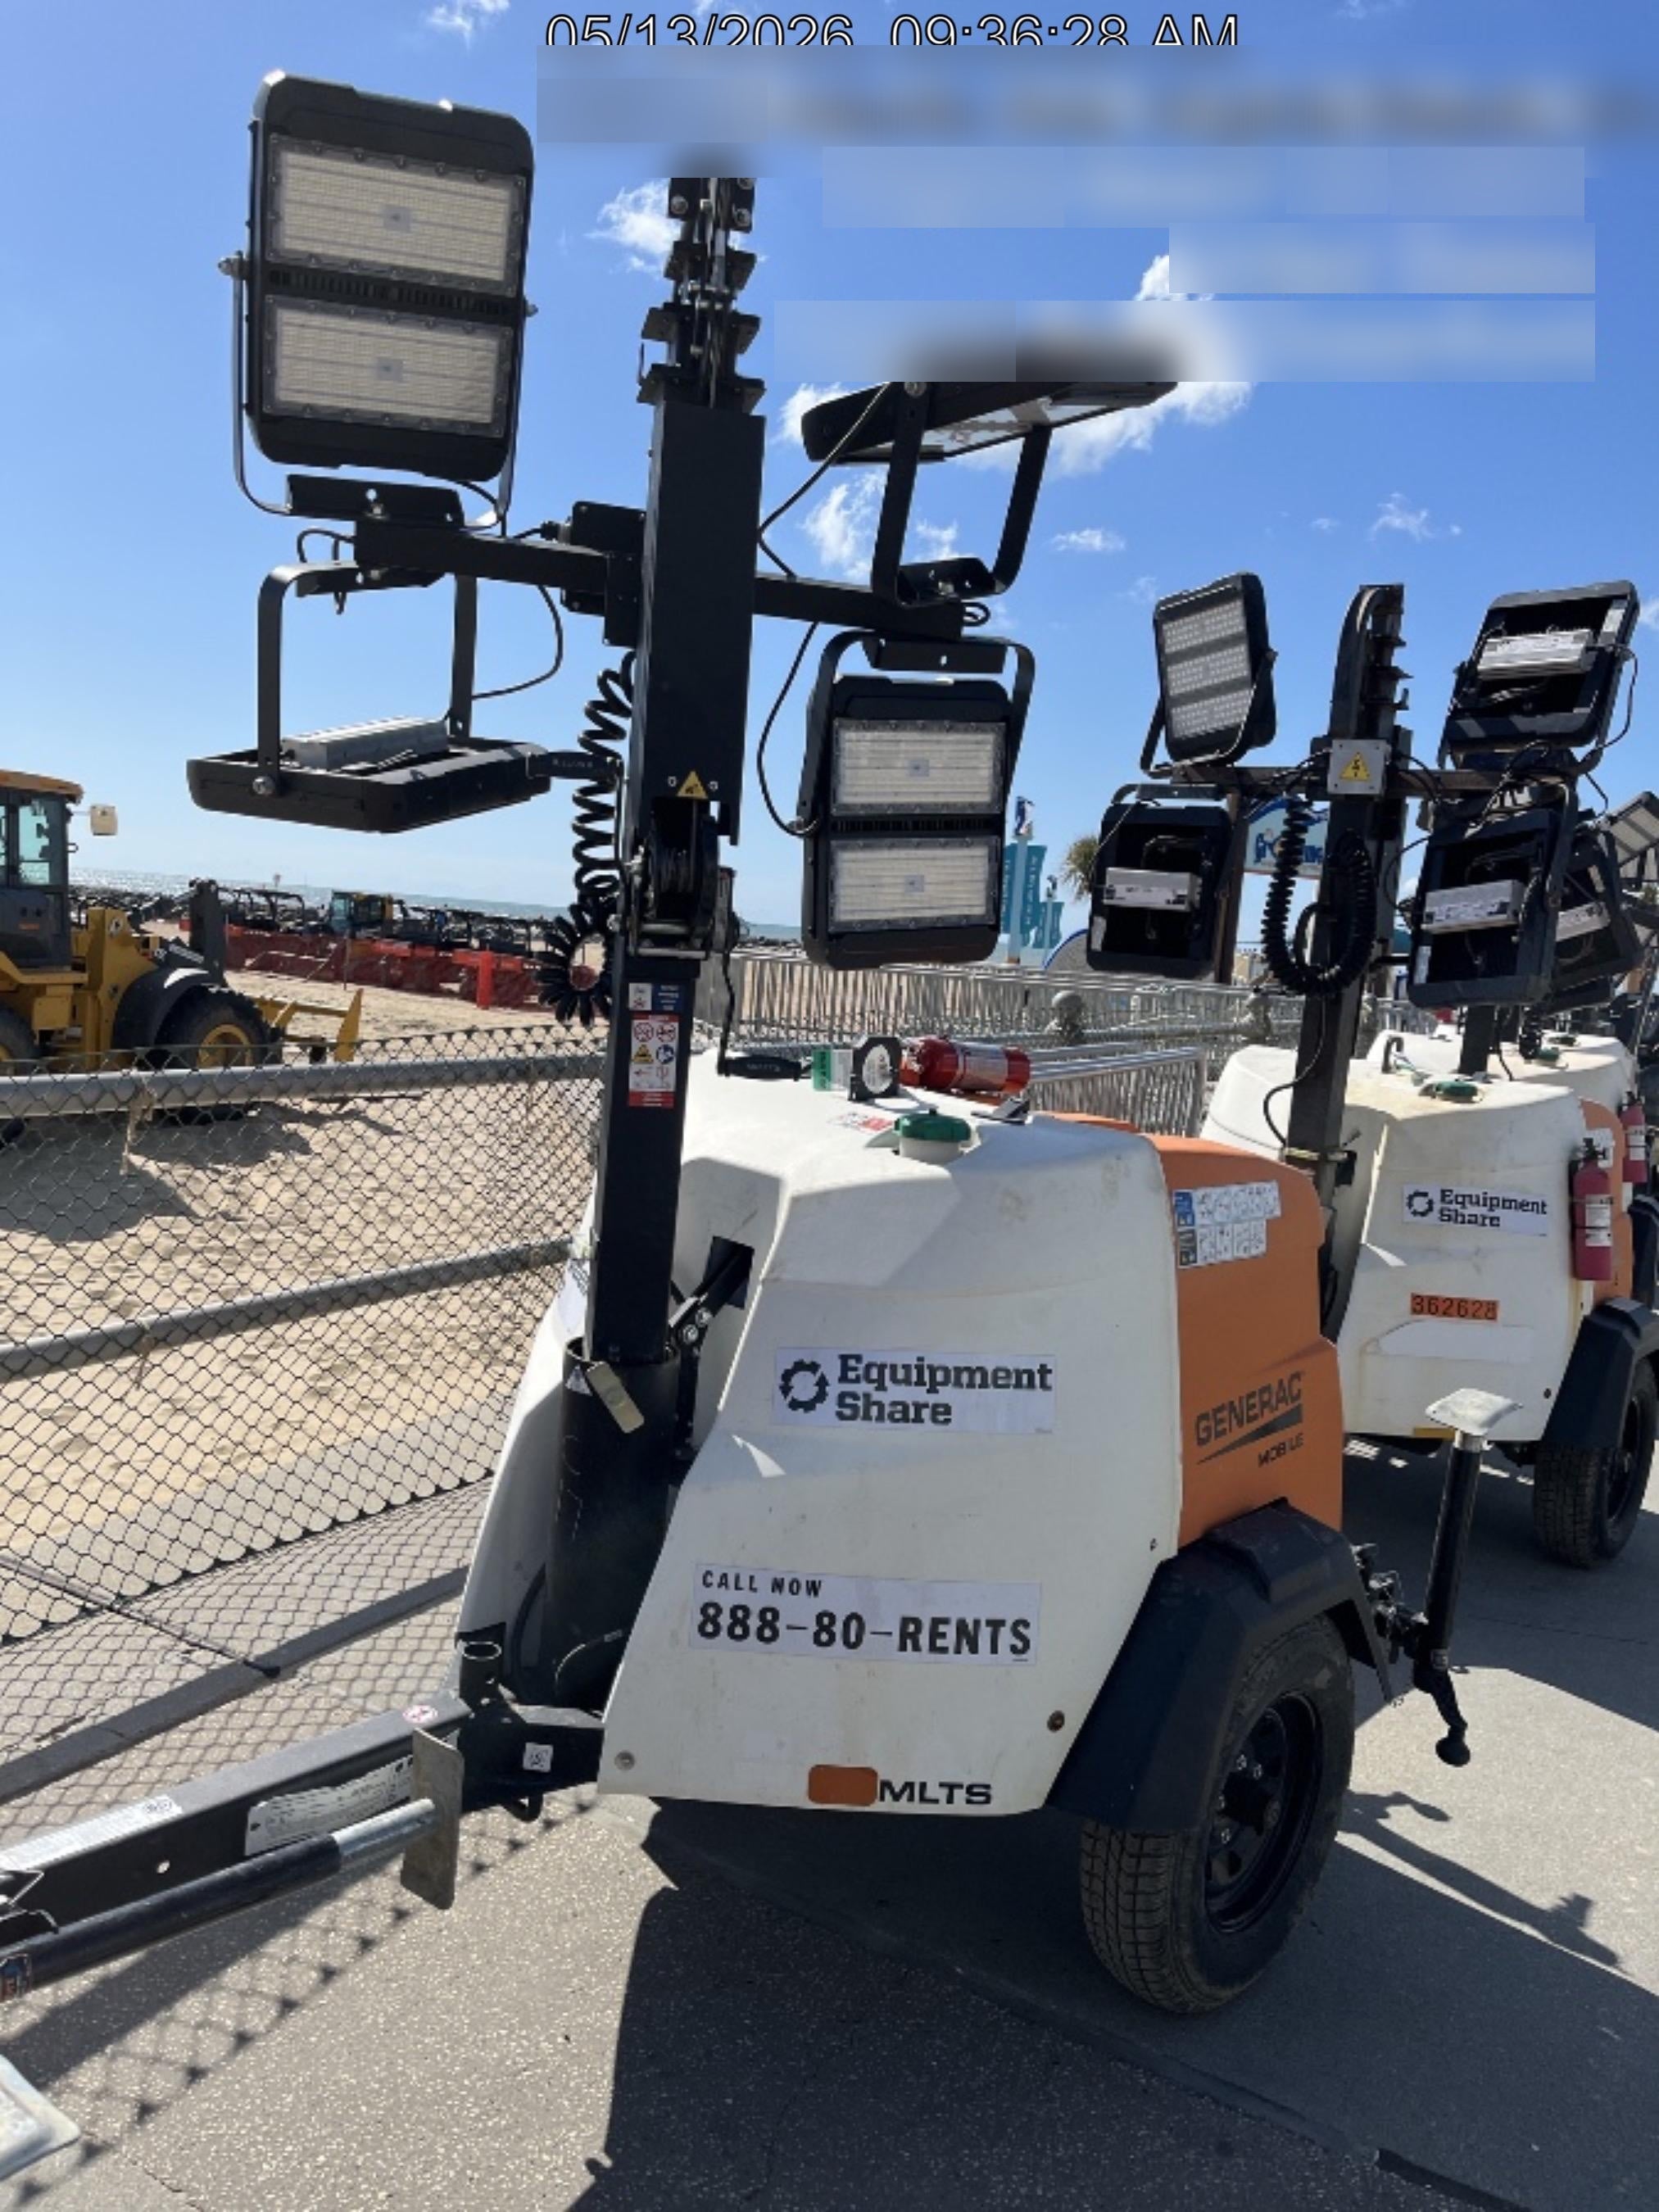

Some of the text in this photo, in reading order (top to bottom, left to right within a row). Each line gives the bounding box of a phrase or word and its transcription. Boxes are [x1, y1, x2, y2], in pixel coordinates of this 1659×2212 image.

[1439, 1189, 1548, 1215] Equipment
[1438, 1208, 1501, 1227] Share
[1412, 1295, 1498, 1320] 362628
[837, 1353, 1054, 1394] Equipment
[835, 1390, 952, 1426] Share
[1195, 1371, 1303, 1447] GENERAC
[701, 1570, 823, 1598] CALL NOW
[697, 1601, 1031, 1657] 888-80-RENTS
[879, 1779, 992, 1805] MLTS
